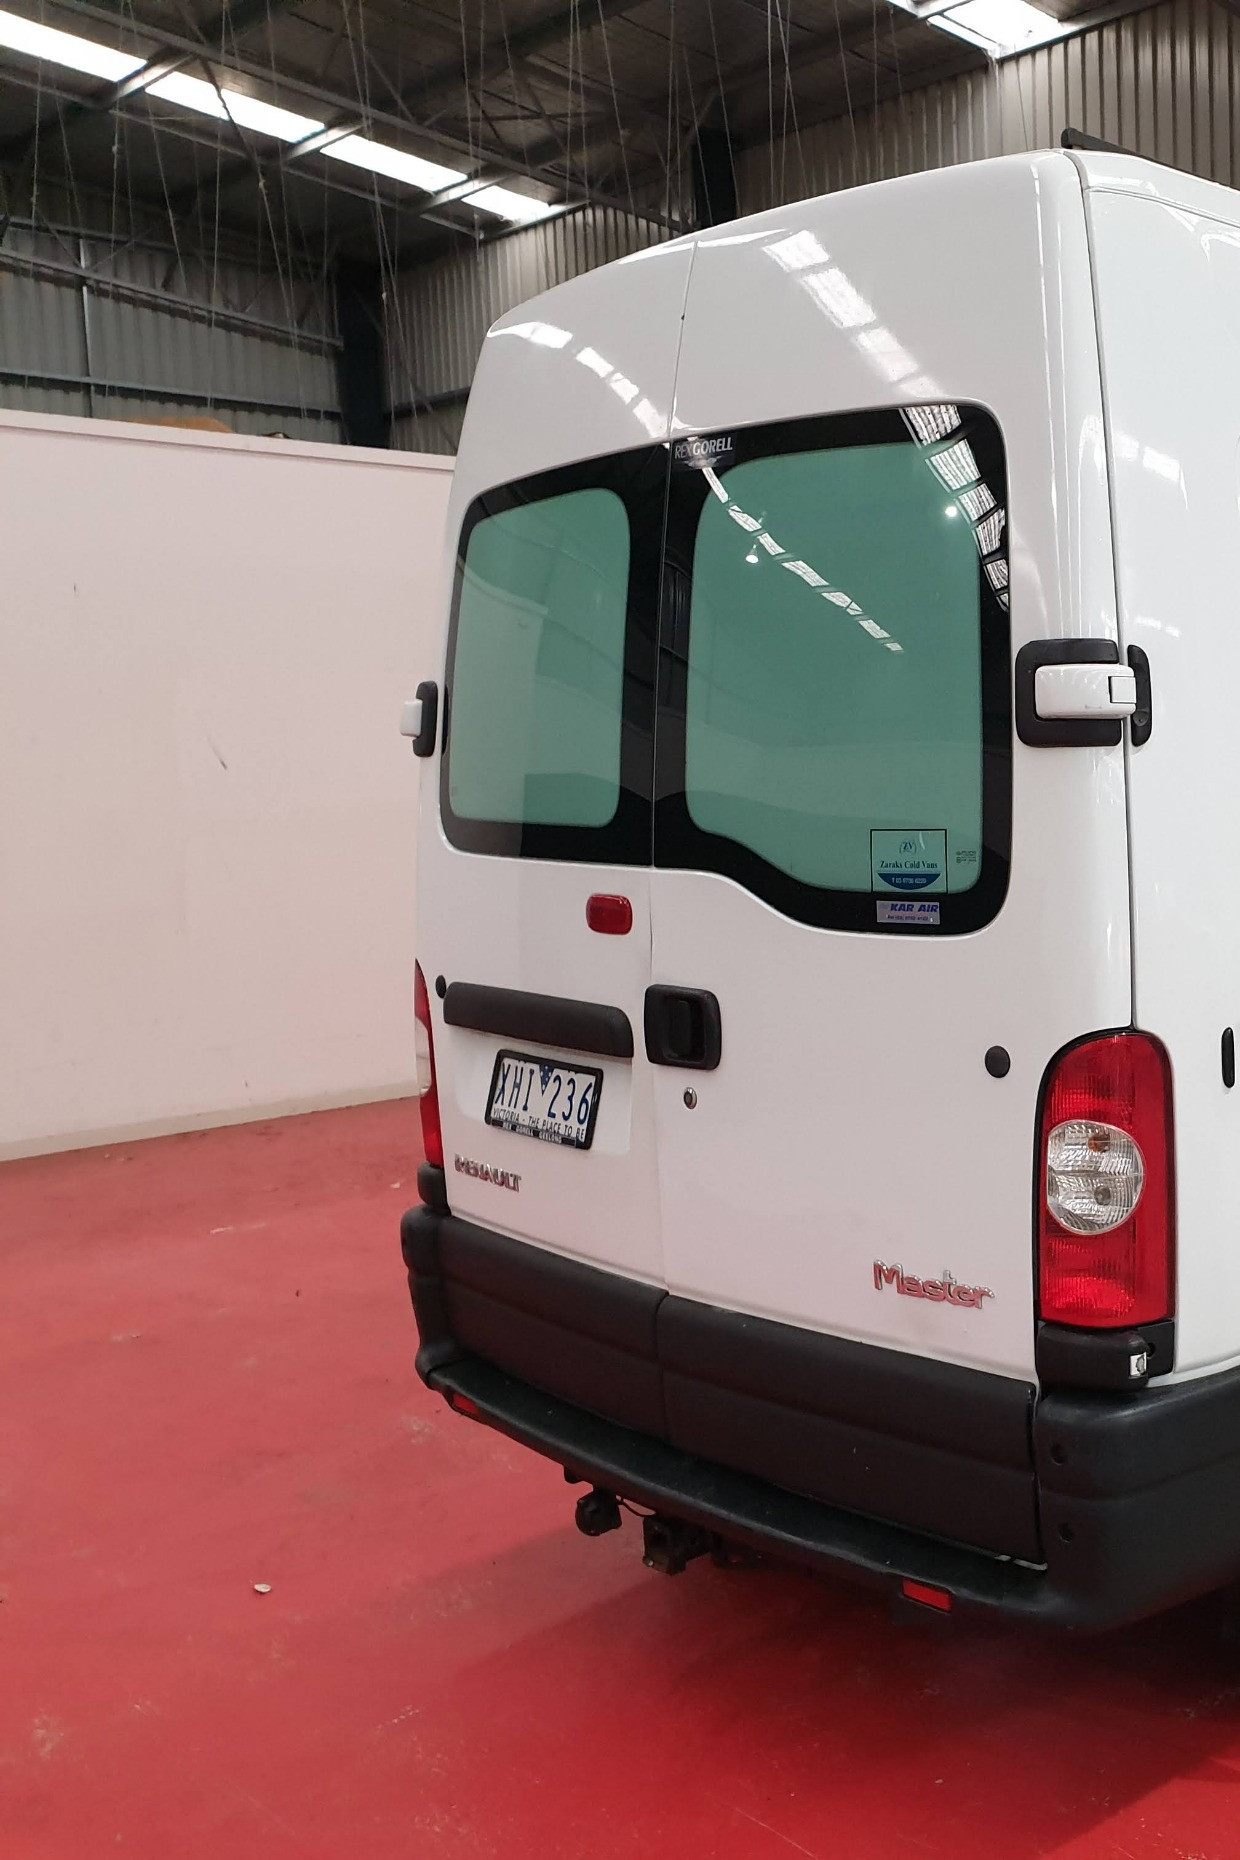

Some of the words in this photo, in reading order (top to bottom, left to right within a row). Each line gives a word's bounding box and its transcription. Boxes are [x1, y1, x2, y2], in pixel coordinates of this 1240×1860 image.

[880, 860, 903, 869] Zaraks
[904, 860, 920, 869] Cold
[921, 860, 938, 869] Vans
[890, 903, 915, 912] KAR
[918, 904, 939, 913] AIR
[494, 1062, 536, 1112] XHI
[547, 1074, 593, 1125] 236
[493, 1108, 520, 1122] VICTORIA
[529, 1115, 540, 1129] THE
[542, 1119, 562, 1135] PLACE
[563, 1124, 573, 1137] TO
[575, 1128, 585, 1140] BE
[454, 1153, 522, 1193] RENAULT
[873, 1259, 995, 1309] Master
